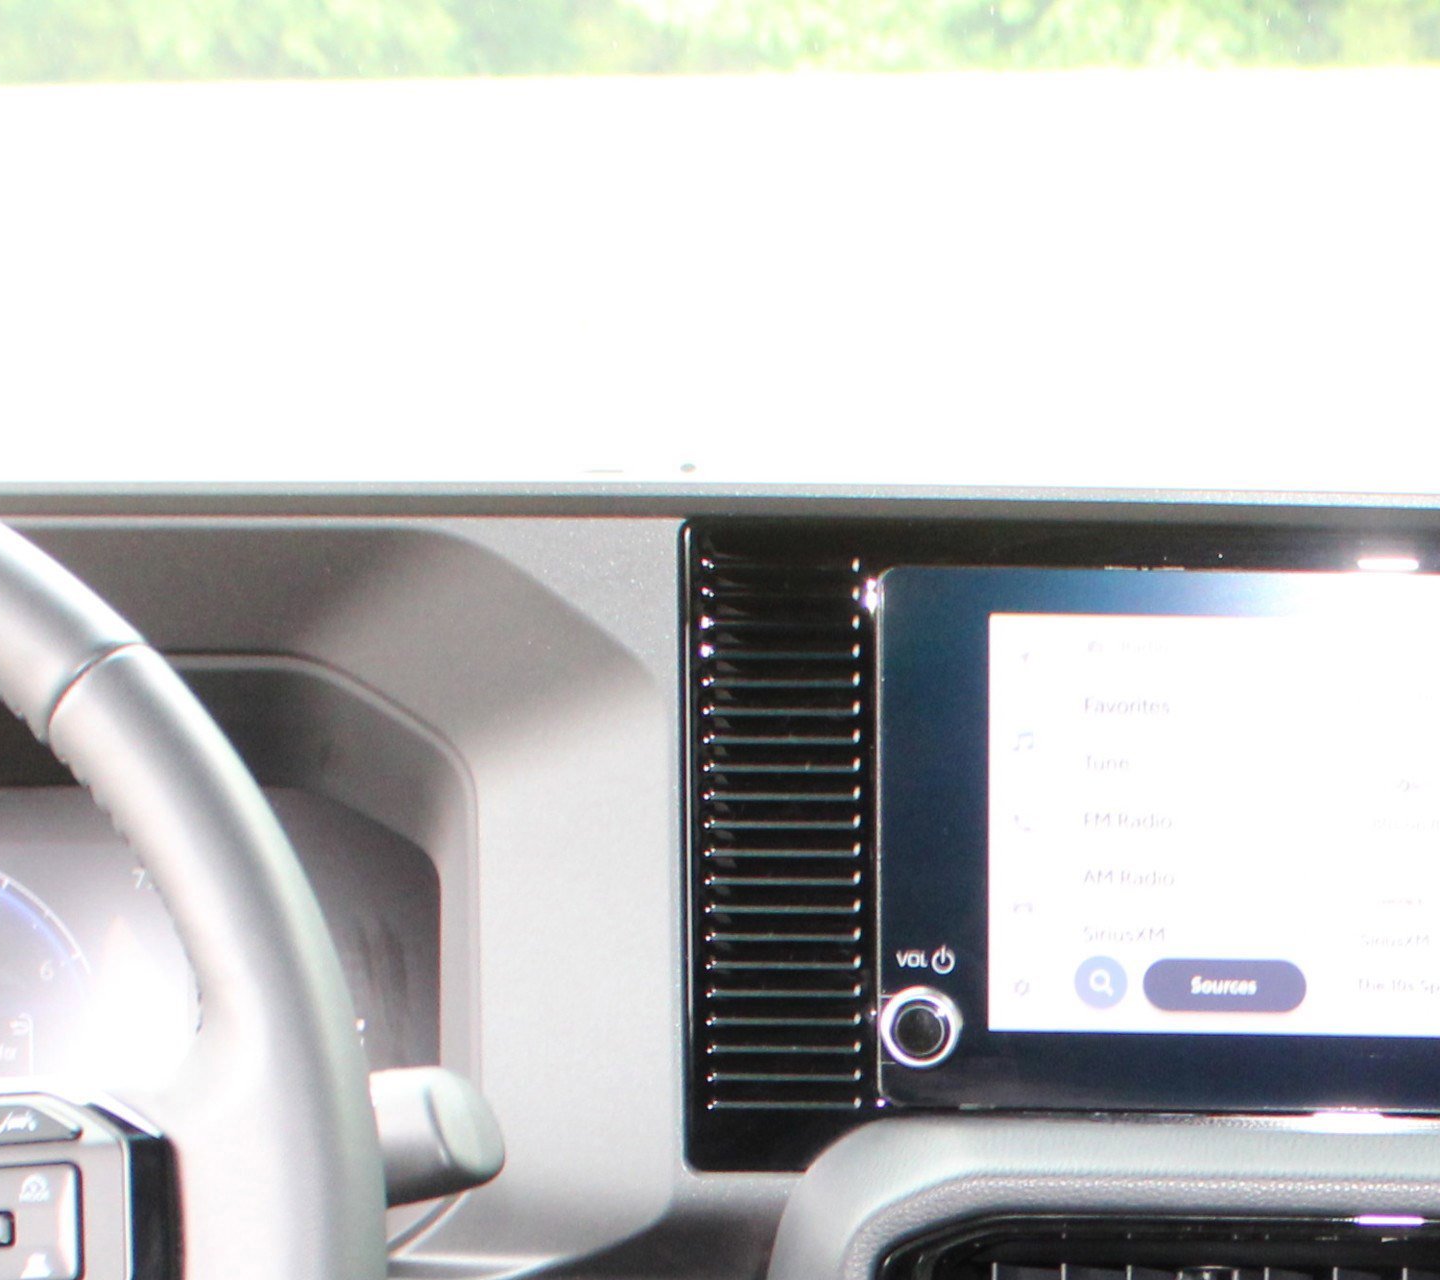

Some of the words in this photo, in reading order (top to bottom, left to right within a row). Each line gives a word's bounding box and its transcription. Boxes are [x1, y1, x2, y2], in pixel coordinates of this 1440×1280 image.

[1083, 696, 1170, 715] Favorites
[1084, 755, 1130, 771] Tune
[1083, 812, 1113, 828] FM
[1118, 812, 1174, 829] Radio
[1082, 870, 1114, 885] AM
[1121, 869, 1176, 887] Radio
[1082, 924, 1167, 943] SiriusXM
[896, 949, 929, 968] VOL
[40, 963, 54, 982] 6
[1192, 976, 1257, 994] Sources
